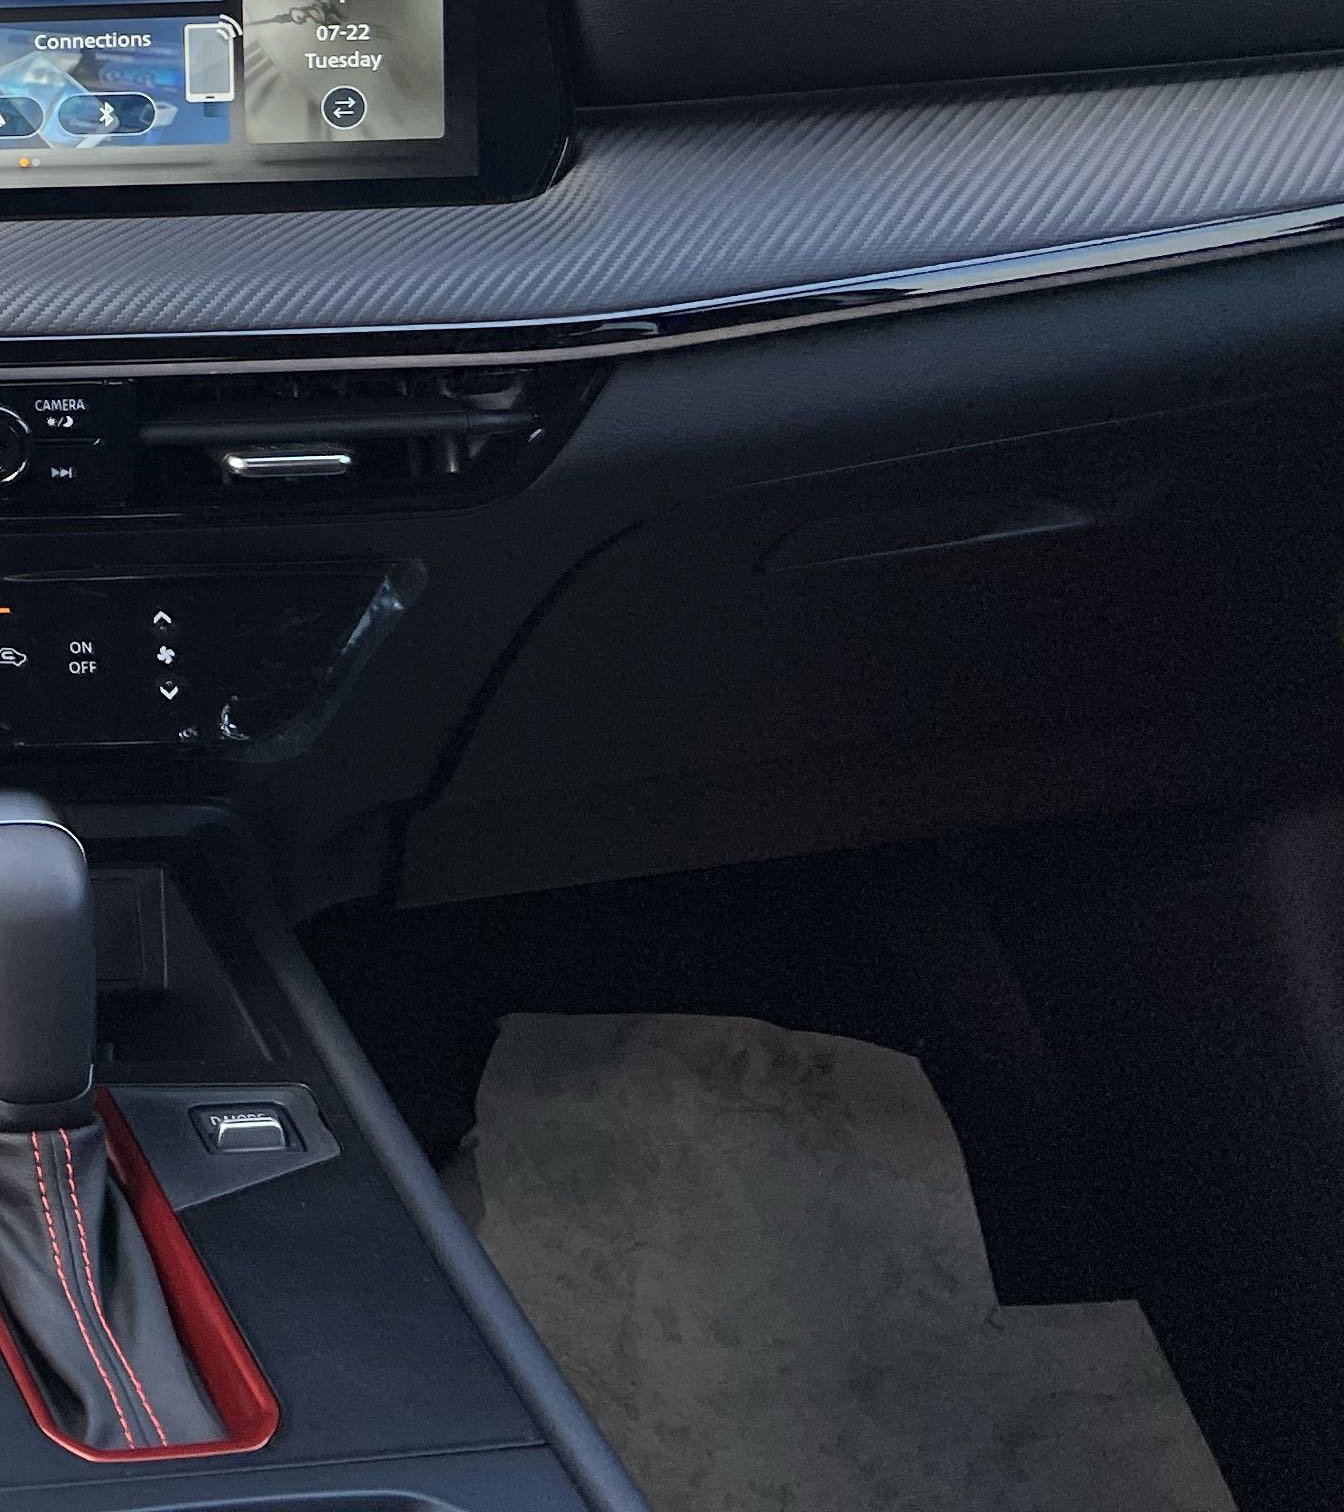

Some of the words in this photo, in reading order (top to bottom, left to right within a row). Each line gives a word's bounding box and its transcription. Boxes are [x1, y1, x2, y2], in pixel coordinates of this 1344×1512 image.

[33, 31, 152, 50] Connections
[316, 24, 371, 42] 07-22
[304, 51, 383, 72] Tuesday
[35, 399, 86, 412] CAMERA
[69, 641, 93, 655] ON
[69, 660, 98, 675] OFF
